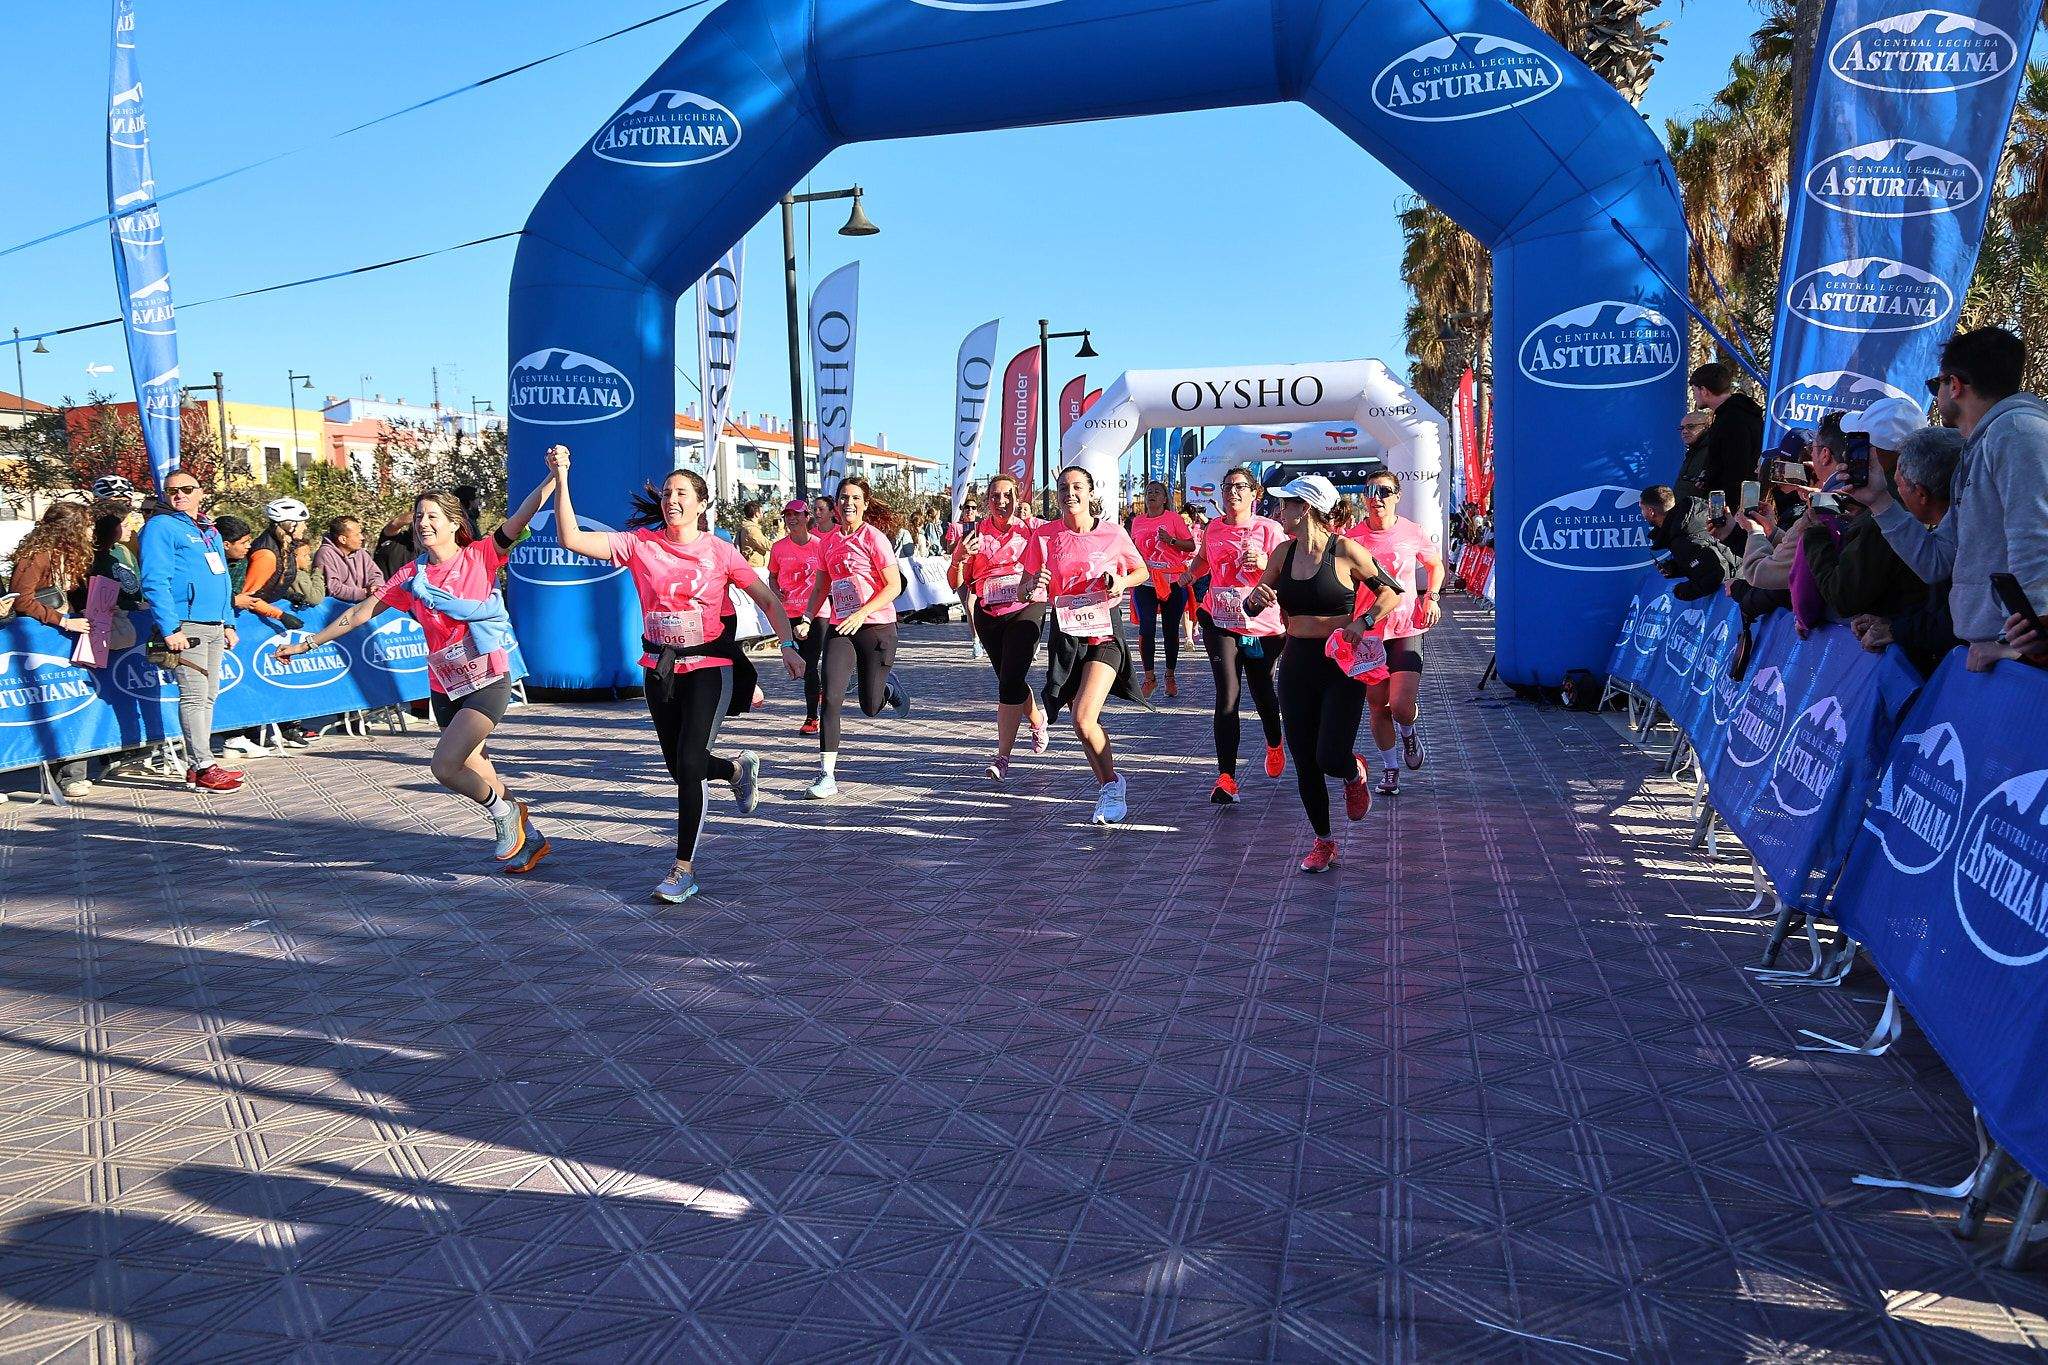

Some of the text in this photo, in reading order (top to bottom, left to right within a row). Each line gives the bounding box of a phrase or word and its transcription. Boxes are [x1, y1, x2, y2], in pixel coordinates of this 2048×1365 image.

[1874, 38, 1999, 48] CENTRAL LECHERA
[1412, 57, 1541, 78] CENTRAL LECHERA
[1840, 40, 1999, 73] ASTURIANA
[1386, 67, 1552, 109] ASTURIANA
[622, 113, 724, 127] CENTRAL LECHERA
[598, 125, 730, 151] ASTURIANA
[1848, 165, 1903, 174] CENTRAL
[1816, 167, 1966, 201] ASTURIANA
[1825, 281, 1939, 295] CENTRAL LECHERA
[1796, 282, 1938, 318] ASTURIANA
[1555, 329, 1671, 343] CENTRAL LECHERA
[1528, 339, 1675, 372] ASTURIANA
[520, 374, 618, 385] CENTRAL LECHERA
[510, 378, 624, 408] ASTURIANA
[1171, 375, 1324, 412] OYSHO
[1800, 392, 1847, 404] CENTRAL
[957, 356, 992, 480] YSHO
[1012, 373, 1029, 456] Santander
[1369, 405, 1417, 418] OYSHO
[1084, 419, 1128, 429] OYSHO
[1296, 470, 1367, 478] VOLVO
[1396, 470, 1440, 482] OYSHO
[1555, 515, 1614, 525] CENTRAL
[1529, 519, 1654, 550] ASTURIA
[1075, 612, 1095, 622] 016
[664, 635, 686, 644] 016
[373, 639, 429, 663] ASTURIA
[263, 653, 347, 676] ASTURIANA
[456, 661, 478, 676] 016
[0, 680, 93, 709] TURIANA
[1990, 817, 2031, 851] CENTRAL
[1959, 814, 2048, 938] ASTURIAN
